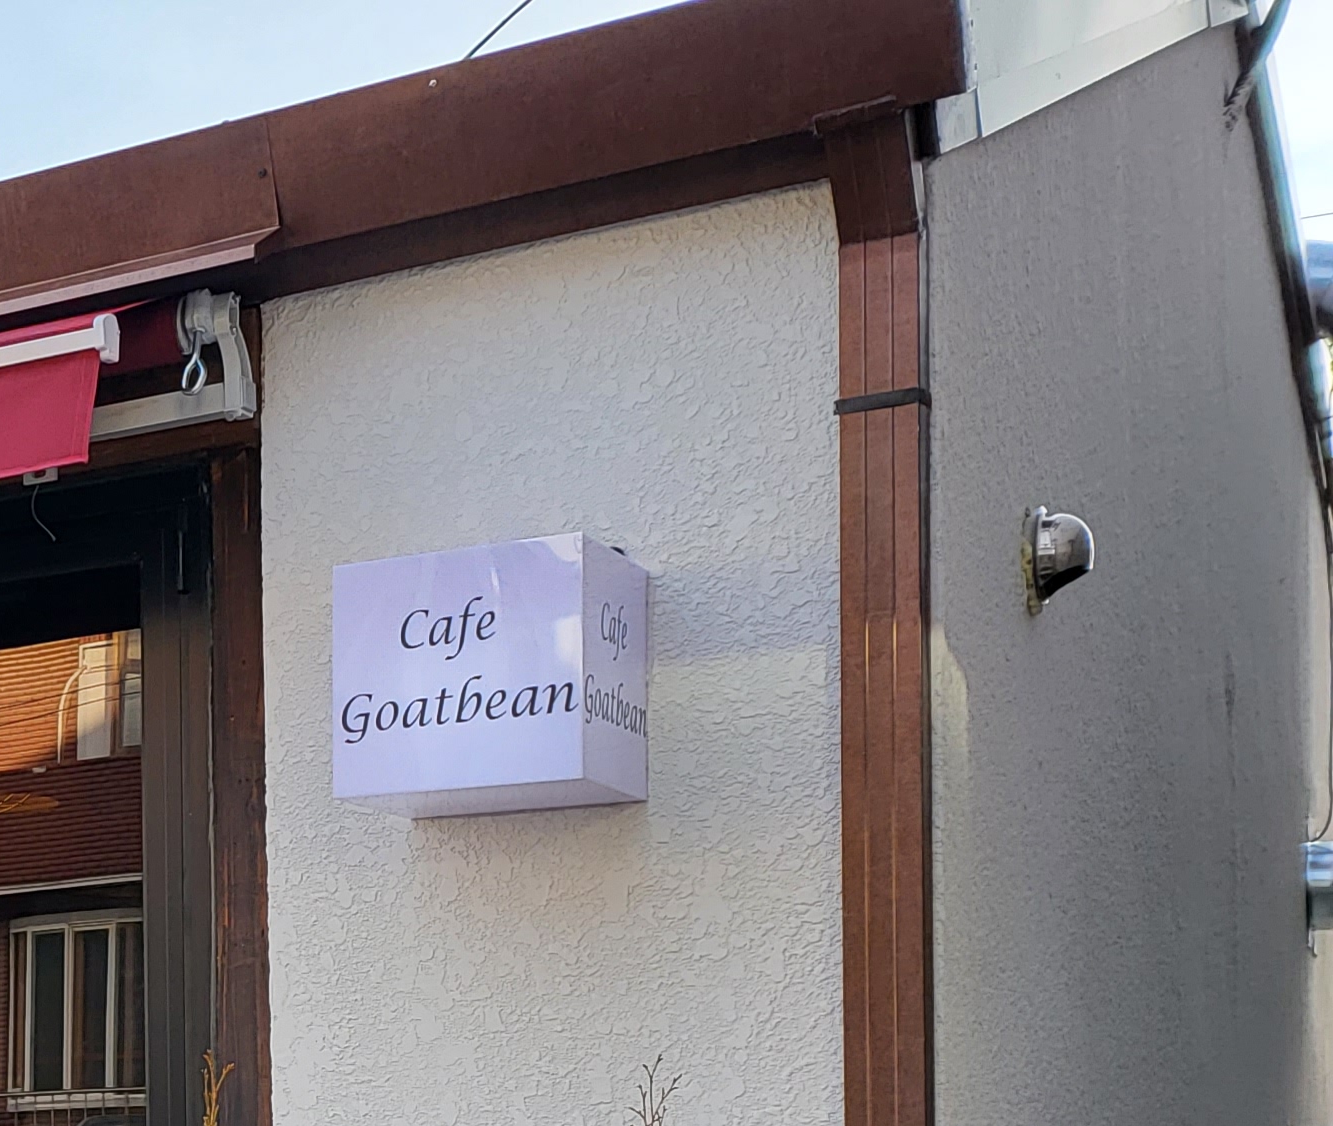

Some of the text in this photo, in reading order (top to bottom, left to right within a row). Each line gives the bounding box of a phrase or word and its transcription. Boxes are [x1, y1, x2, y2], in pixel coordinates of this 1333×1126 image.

[400, 596, 496, 661] Cafe
[600, 602, 628, 661] Cafe
[341, 675, 579, 744] Goatbean
[584, 673, 647, 738] Goatbean
